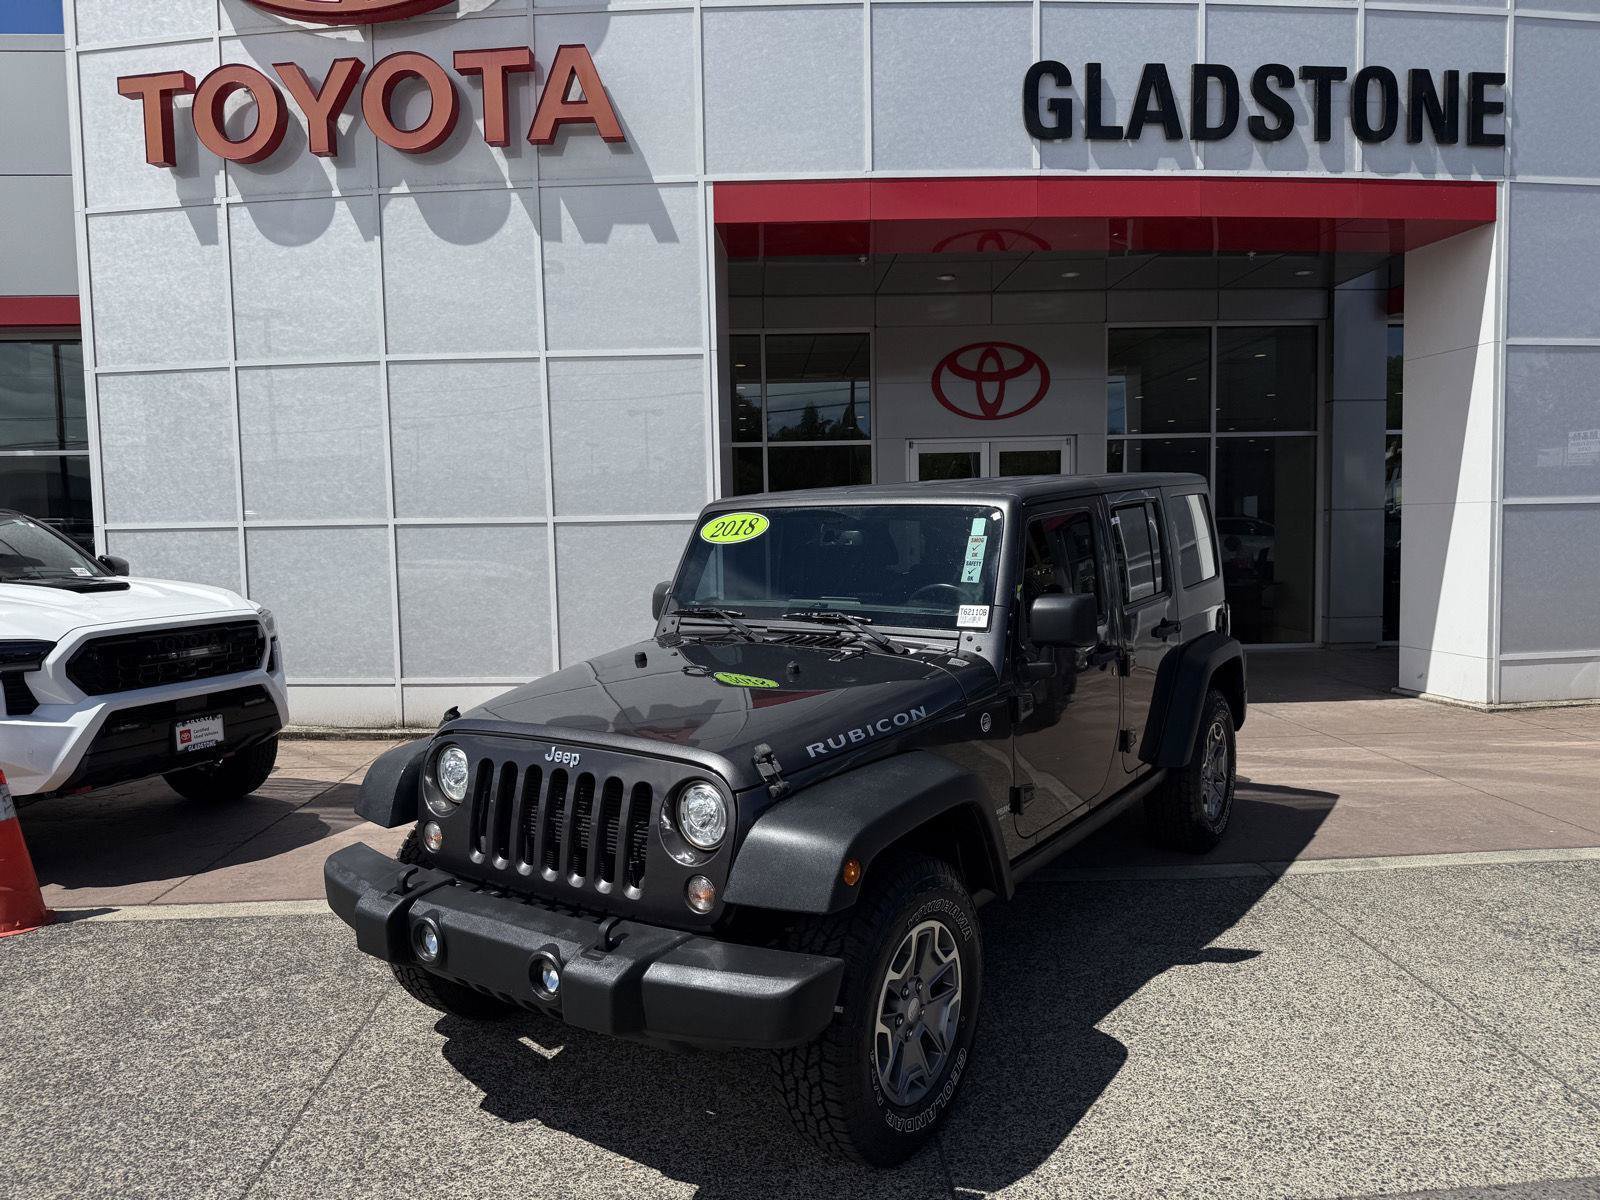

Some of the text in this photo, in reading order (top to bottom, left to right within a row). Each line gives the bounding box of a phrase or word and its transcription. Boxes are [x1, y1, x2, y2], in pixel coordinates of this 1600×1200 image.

[117, 43, 627, 167] TOYOTA
[1023, 60, 1506, 146] GLADSTONE
[709, 517, 760, 538] 2018
[187, 740, 217, 752] GLADSTONE
[544, 745, 580, 768] Jeep
[806, 705, 927, 758] RUBICON
[885, 1048, 967, 1133] GEOLANDAR
